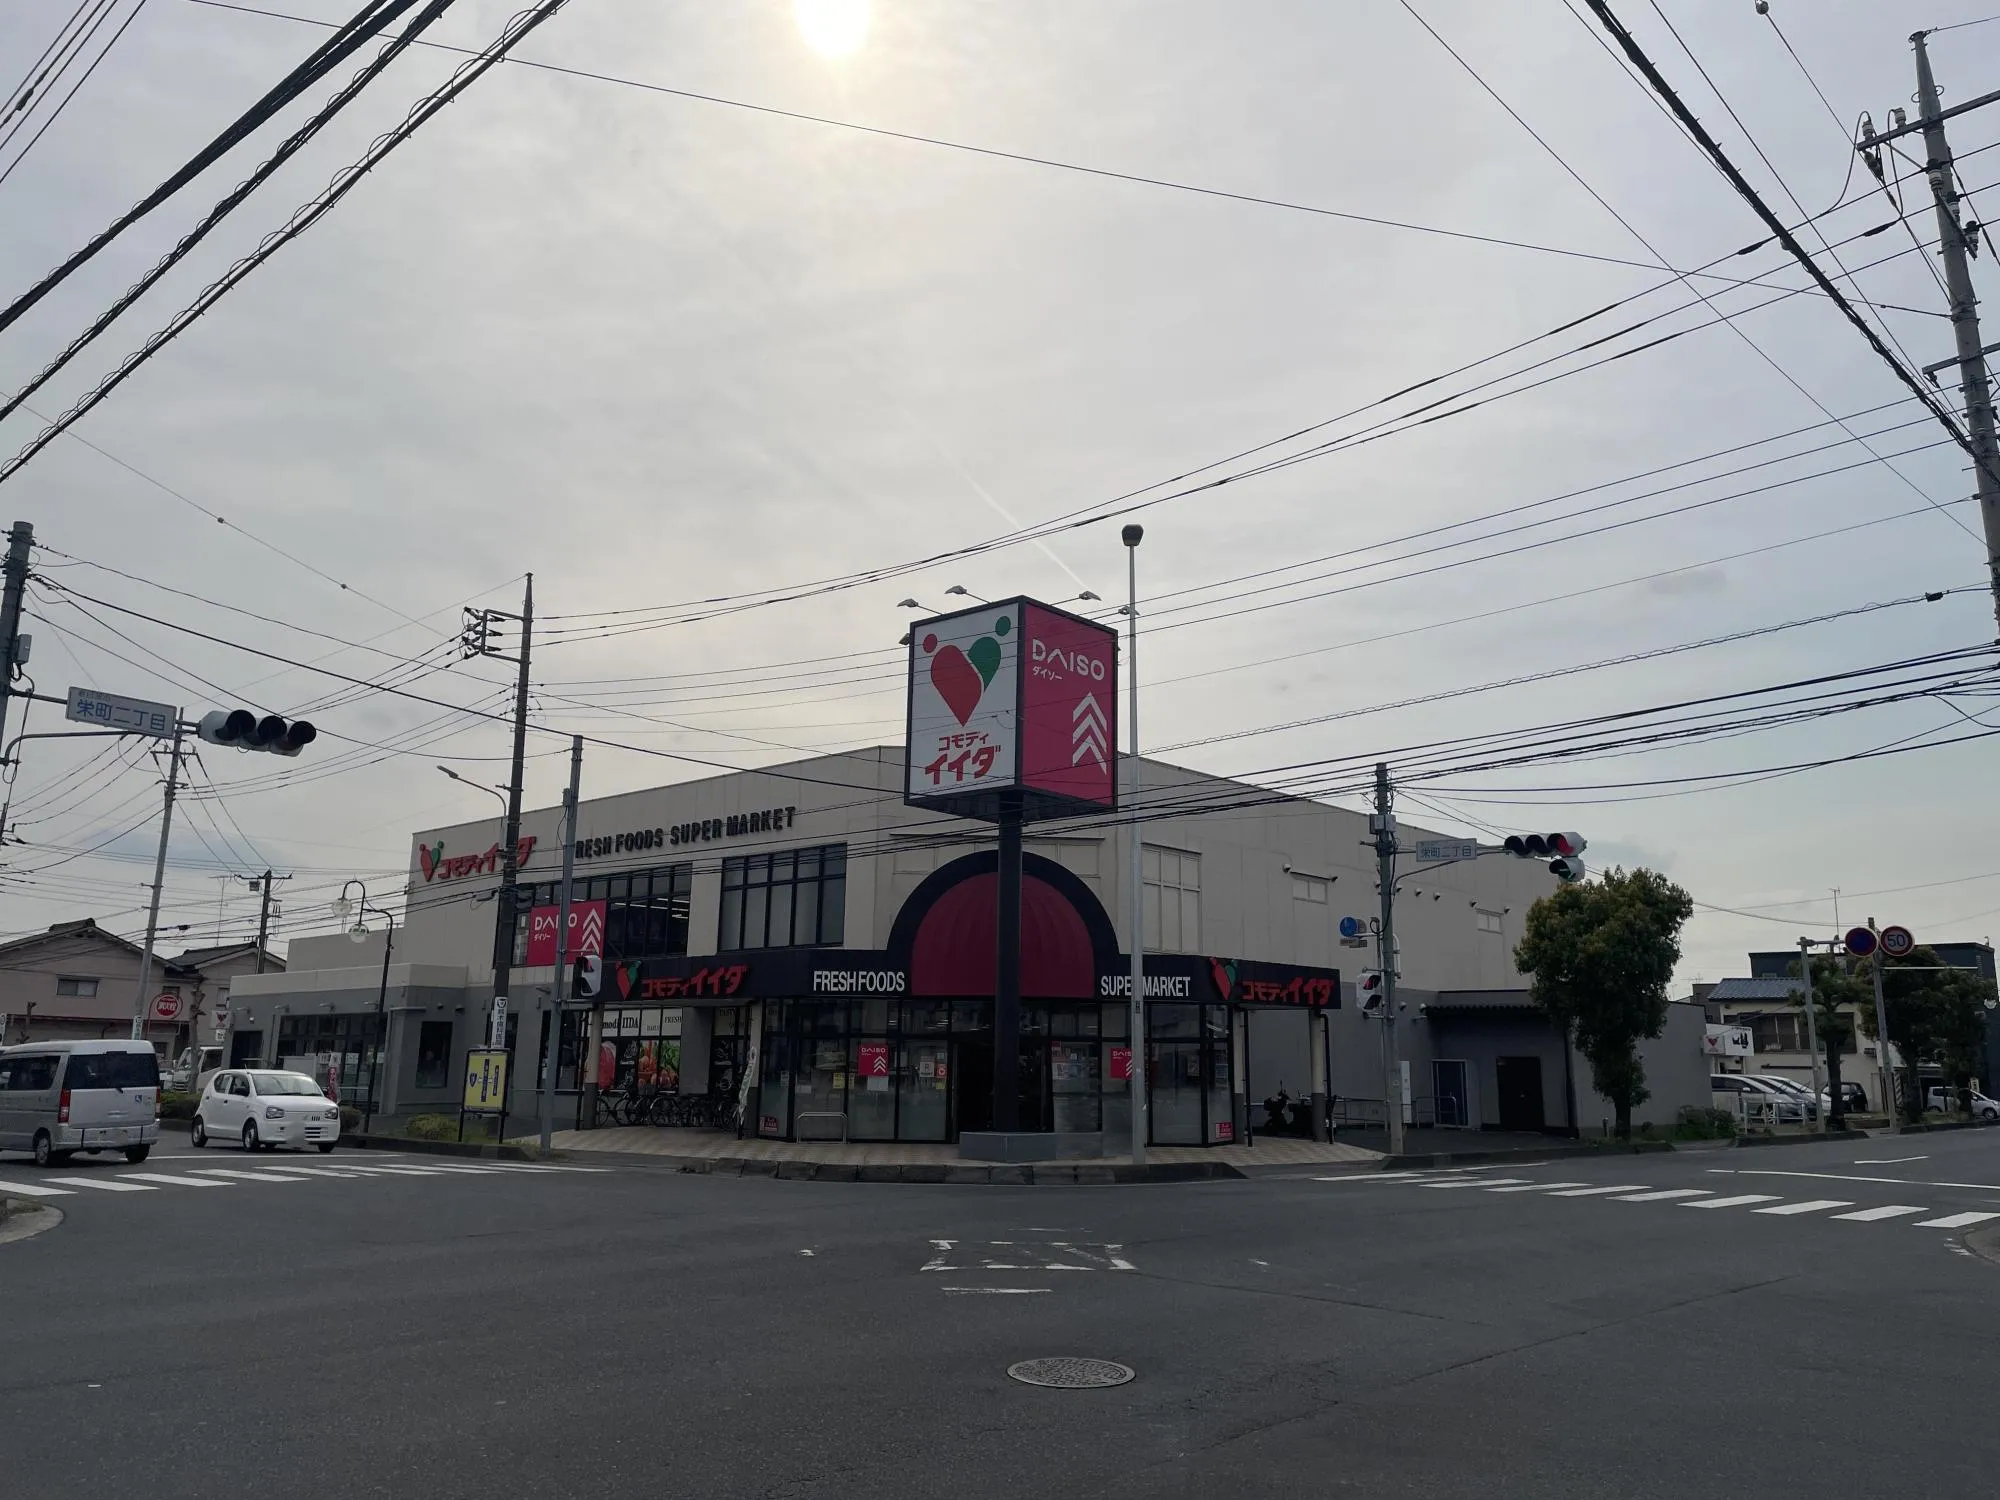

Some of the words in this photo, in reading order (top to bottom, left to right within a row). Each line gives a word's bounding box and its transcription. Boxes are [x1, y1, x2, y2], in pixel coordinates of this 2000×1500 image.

[1032, 638, 1105, 681] DAISO
[1032, 665, 1063, 681] ダイソー
[76, 699, 166, 731] 栄町二丁目
[938, 731, 989, 752] コモディ
[924, 745, 1001, 785] イイダ
[575, 836, 612, 858] RESH
[615, 828, 663, 852] FOODS
[669, 819, 723, 844] SUPER
[726, 806, 796, 836] MARKET
[438, 836, 537, 879] コモディイダ
[534, 913, 577, 931] DAIO
[1887, 934, 1906, 947] 50
[641, 964, 748, 998] コモディイイダ
[813, 970, 857, 992] FRESH
[858, 970, 905, 992] FOODS
[1101, 975, 1132, 997] SUPE
[1143, 976, 1190, 997] MARKET
[1240, 976, 1335, 1005] コモディイイダ
[665, 1016, 682, 1024] FRESH
